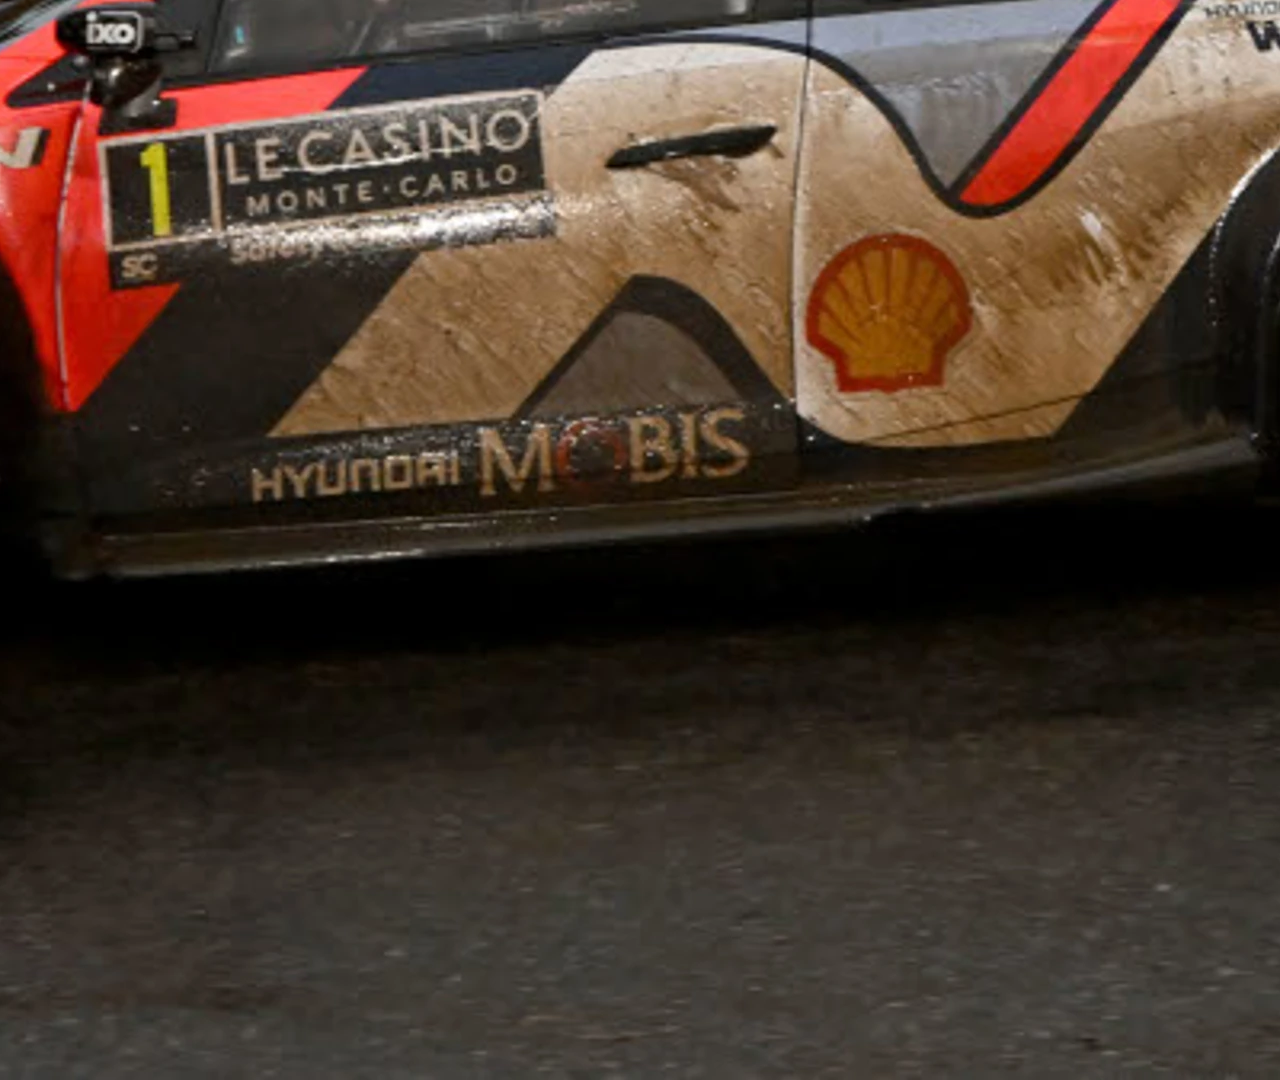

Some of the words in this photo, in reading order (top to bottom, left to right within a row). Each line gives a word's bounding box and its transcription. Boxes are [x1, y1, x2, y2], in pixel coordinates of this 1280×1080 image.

[140, 142, 171, 237] 1
[224, 137, 284, 185] LE
[296, 110, 530, 173] CASINO
[251, 449, 460, 502] HYUNDAI
[477, 408, 750, 497] MOBIS
